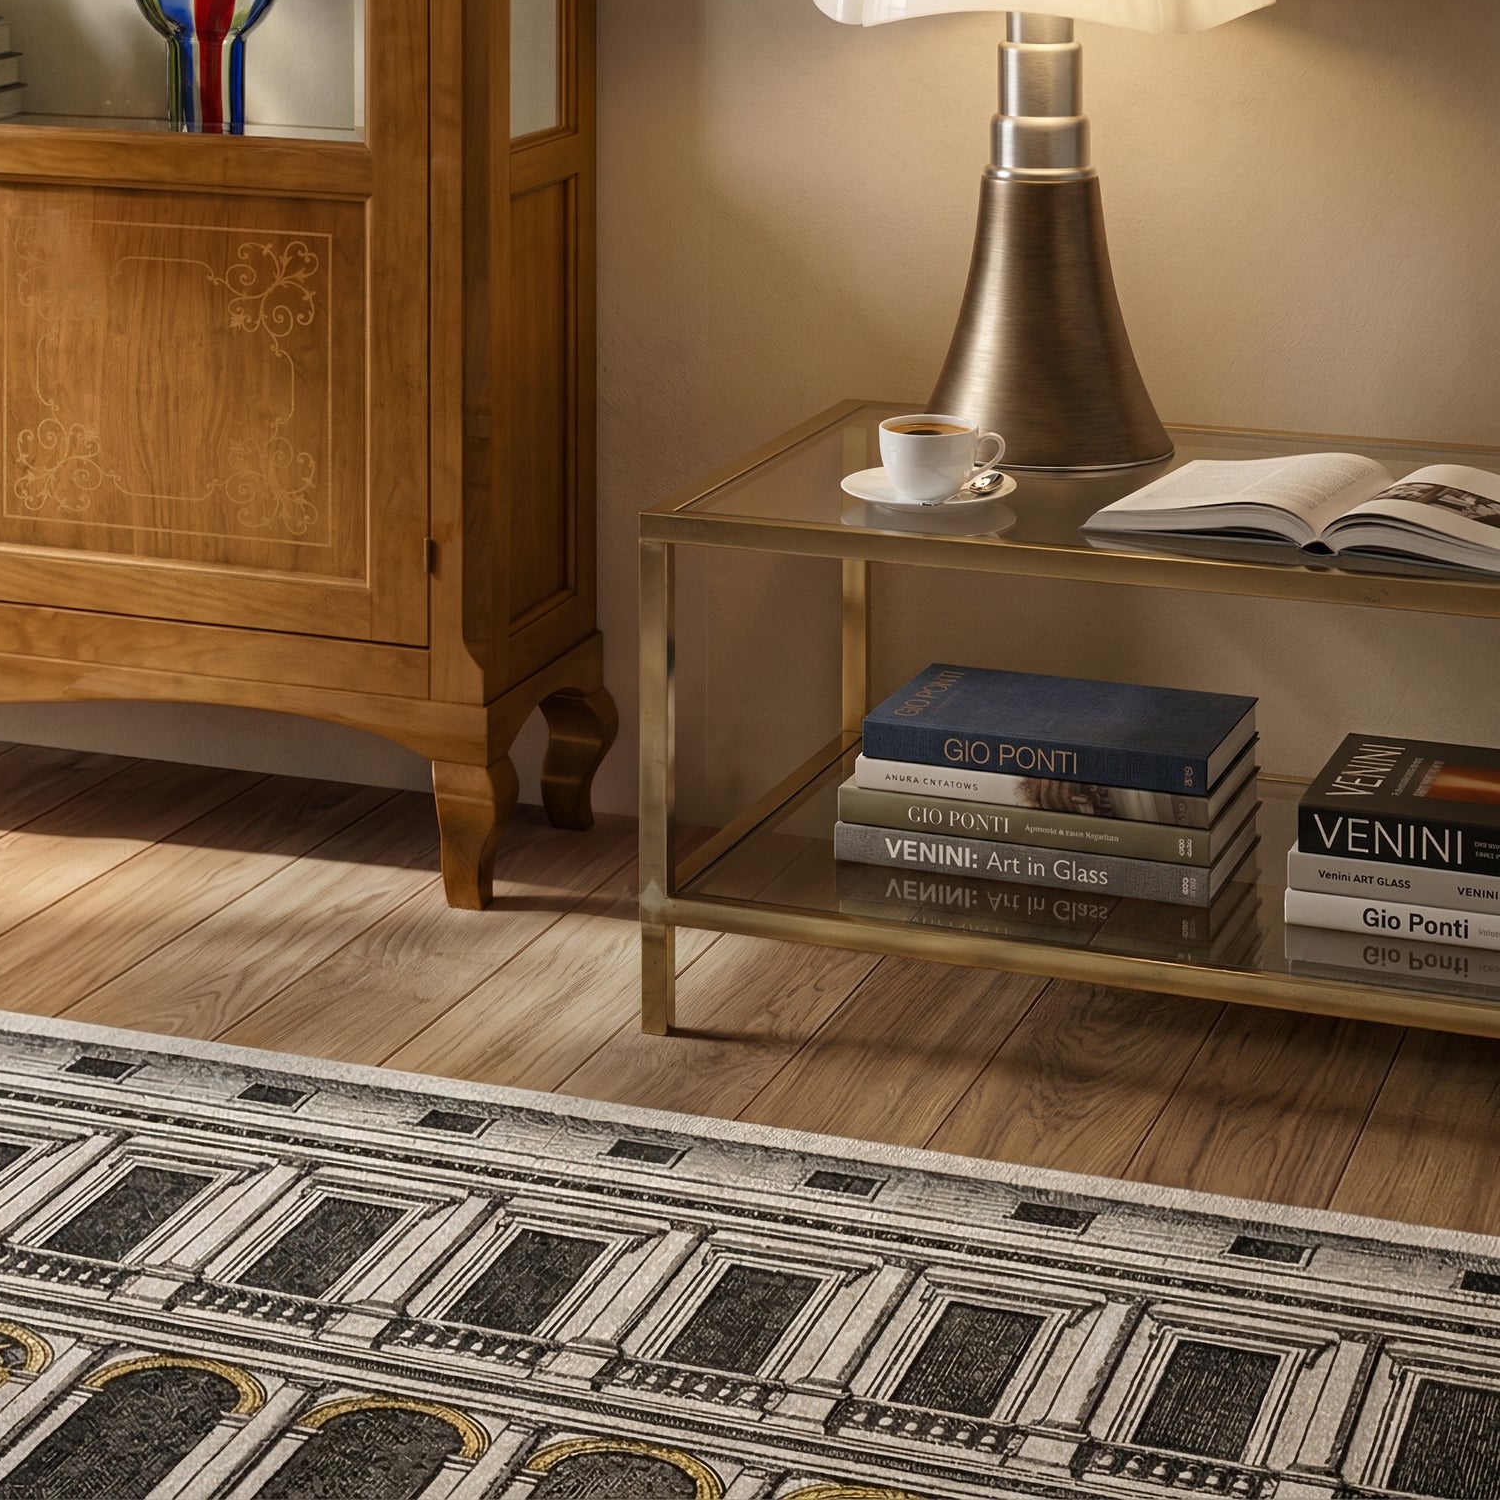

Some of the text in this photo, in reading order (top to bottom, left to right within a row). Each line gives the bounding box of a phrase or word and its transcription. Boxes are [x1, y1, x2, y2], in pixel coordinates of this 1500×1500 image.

[894, 699, 930, 717] GIO
[914, 670, 966, 699] PONTI
[943, 737, 1078, 775] GIO PONTI
[1324, 743, 1406, 796] VENINI
[907, 805, 943, 826] GIO
[950, 810, 1010, 834] PONTI
[1313, 813, 1463, 865] VENINI
[884, 837, 1109, 886] VENINI: Art in Glass
[1318, 869, 1412, 890] Venini ART GLASS
[1457, 886, 1499, 900] VENINI
[1362, 907, 1470, 939] Gio Ponti
